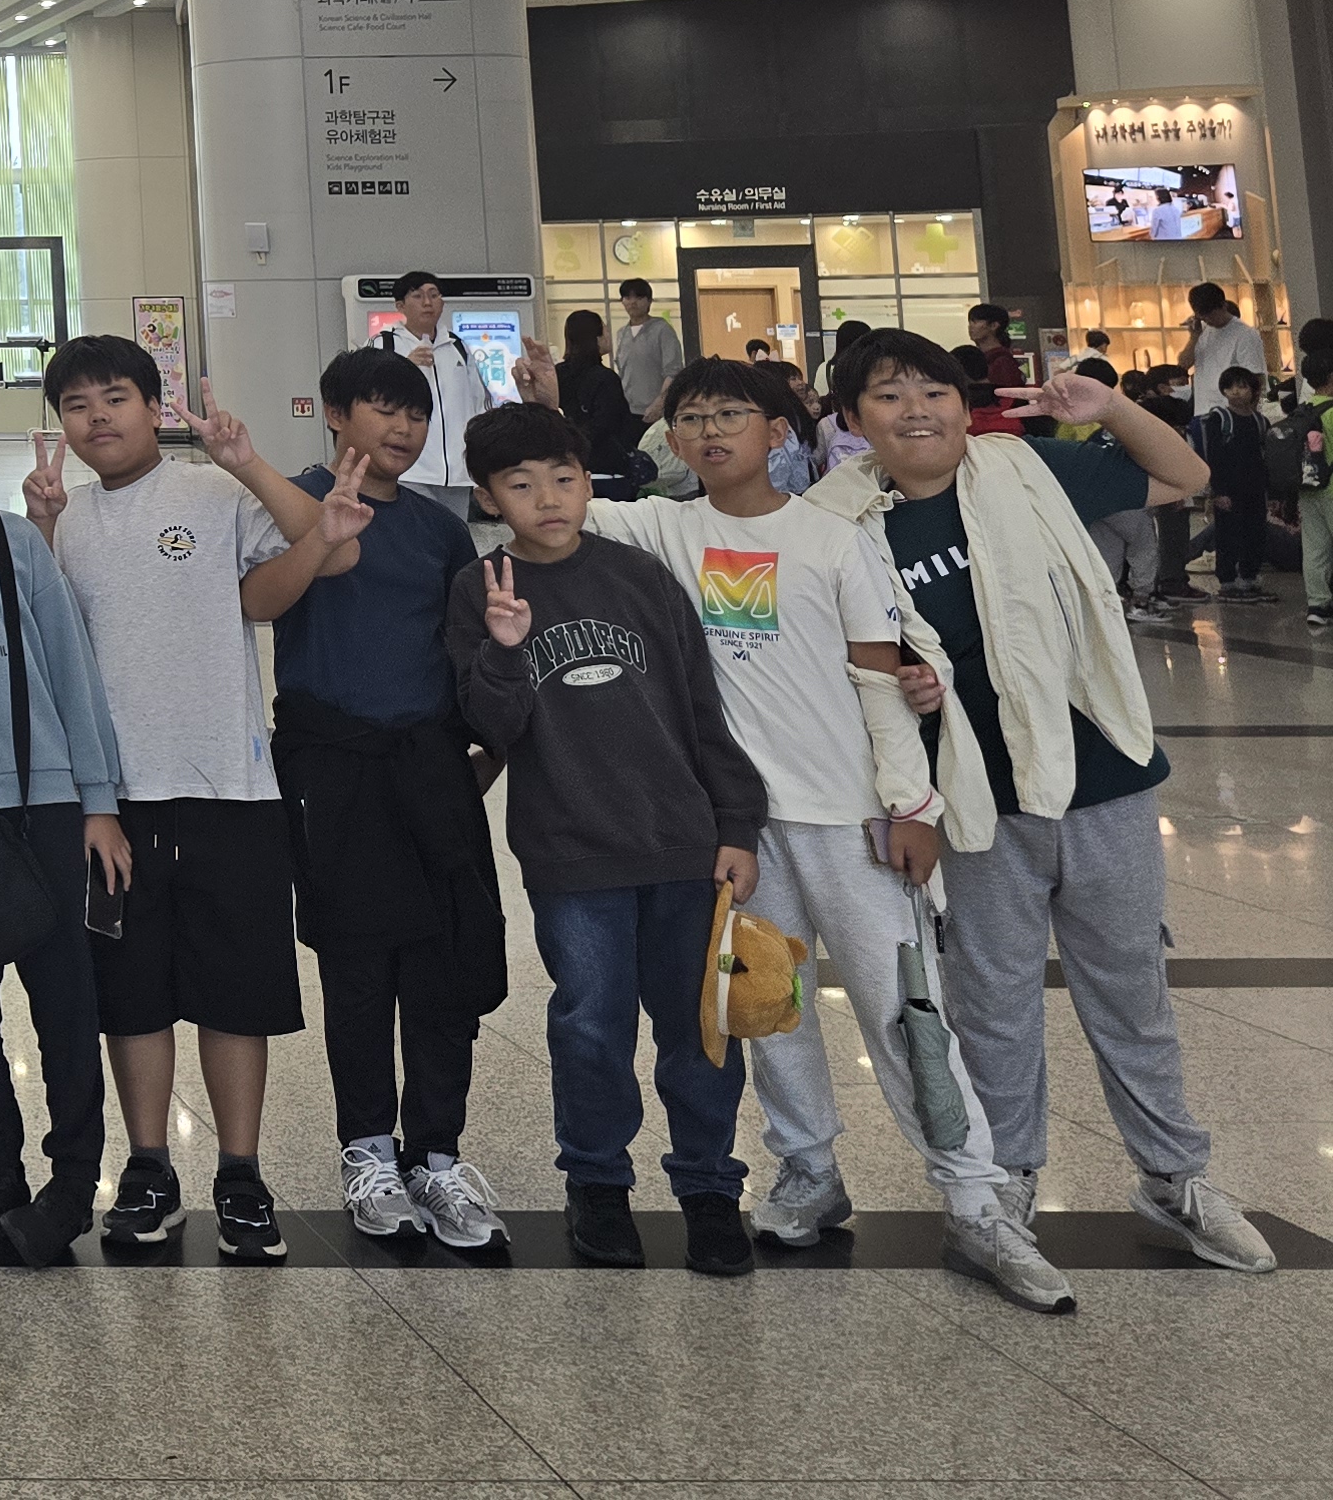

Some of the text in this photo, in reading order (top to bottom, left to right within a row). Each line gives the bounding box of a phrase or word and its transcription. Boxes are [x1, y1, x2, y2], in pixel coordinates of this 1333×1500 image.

[318, 14, 344, 23] Korean
[344, 14, 371, 22] Science
[418, 13, 432, 21] Hall
[319, 24, 346, 32] Science
[324, 68, 351, 94] 1F
[324, 109, 396, 126] 과학탐구관
[325, 128, 398, 145] 유아체험관
[1150, 119, 1182, 142] 도움을
[326, 153, 409, 163] Science Exploration Hall
[344, 164, 383, 173] Playground
[696, 188, 737, 202] 수유실
[744, 186, 786, 201] 의무실
[698, 203, 727, 212] Nursing
[756, 201, 772, 210] First
[773, 201, 786, 209] Aid
[703, 626, 780, 642] GENUINE SPIRIT
[720, 638, 763, 649] SINCE 1921
[570, 671, 594, 683] SINCE
